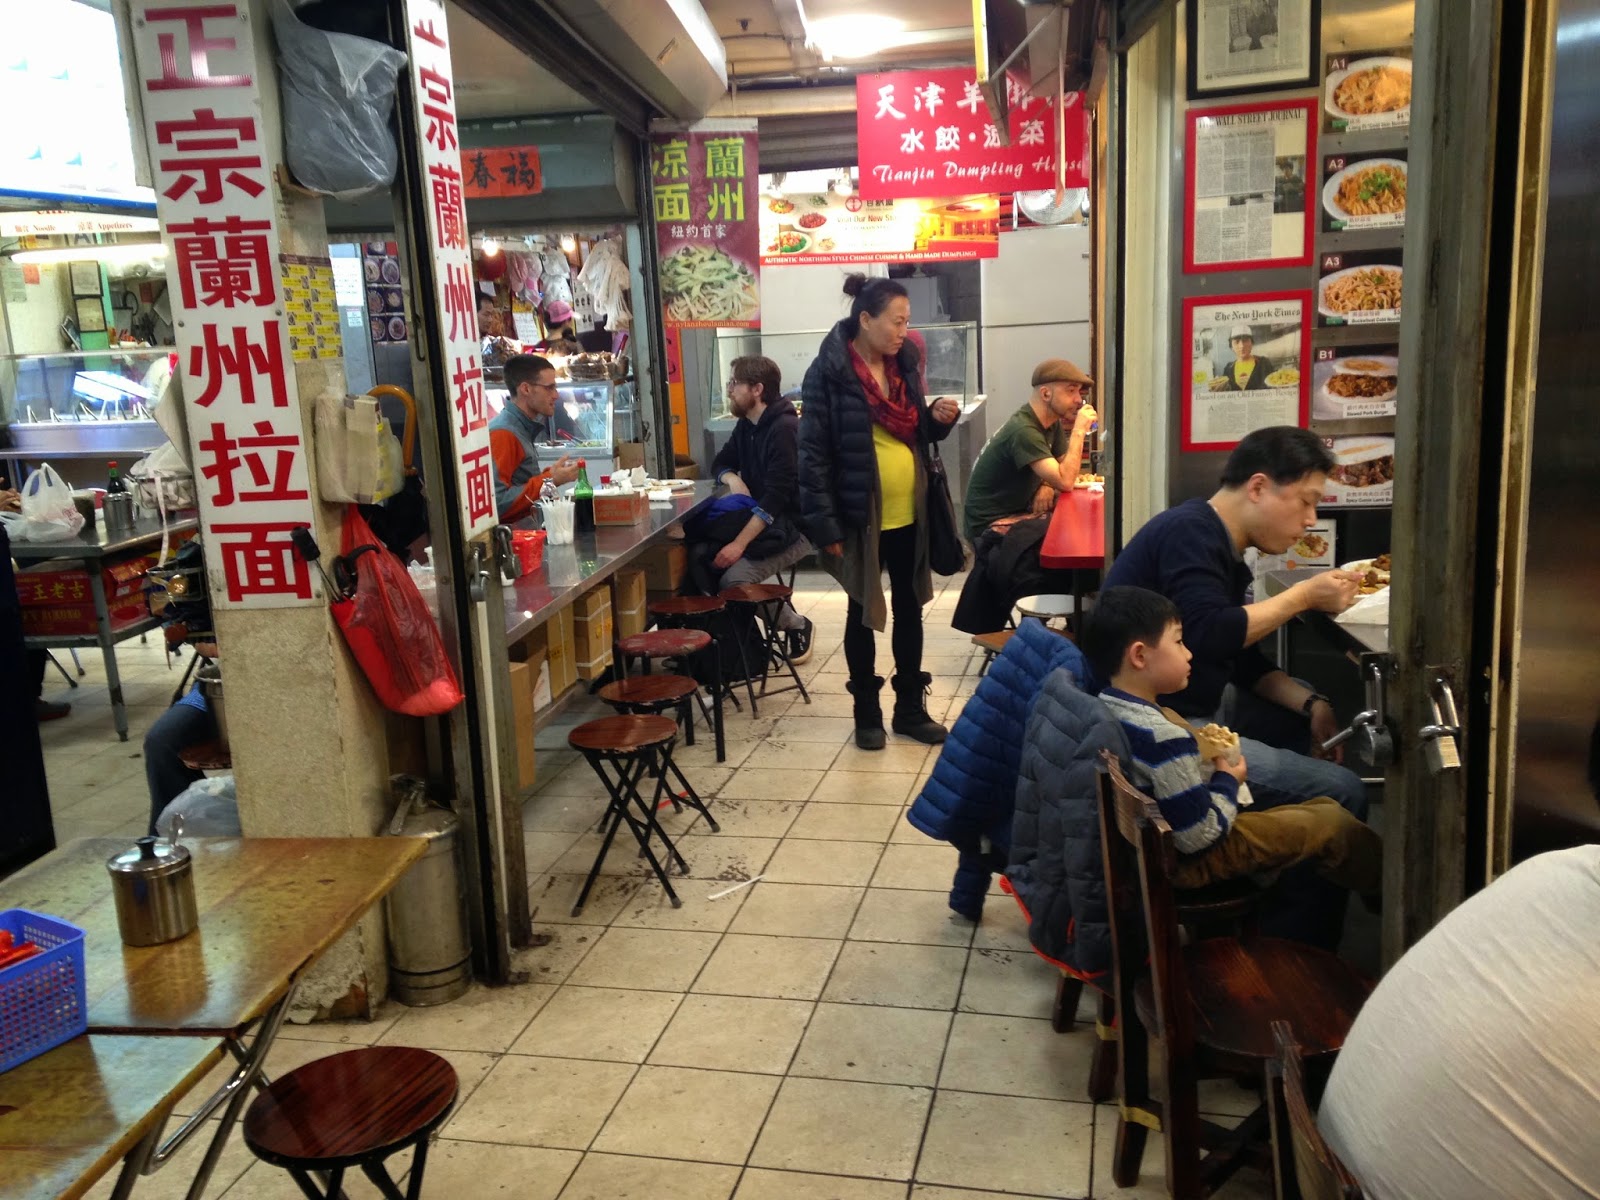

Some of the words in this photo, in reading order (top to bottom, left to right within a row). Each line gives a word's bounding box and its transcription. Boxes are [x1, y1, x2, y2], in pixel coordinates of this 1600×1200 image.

[1331, 58, 1346, 69] A1
[1216, 116, 1236, 126] WALL
[1237, 112, 1267, 125] STREET
[1268, 109, 1303, 122] JOURNAL
[1328, 158, 1344, 169] A2
[872, 164, 935, 185] Tianjin
[943, 158, 1024, 184] Dumpling
[1032, 155, 1082, 173] Hse
[704, 137, 745, 222] 蘭州
[853, 214, 866, 223] Our
[868, 214, 884, 223] New
[33, 224, 57, 232] Noodle
[97, 222, 133, 231] Appetizers
[765, 256, 798, 264] AUTHENTIC
[799, 255, 832, 263] NORTHERN
[832, 254, 849, 263] STYLE
[849, 253, 874, 262] CHINESE
[874, 252, 898, 261] CUISINE
[905, 252, 923, 260] HAND
[924, 251, 941, 259] MADE
[942, 250, 977, 258] DUMPLINGS
[1325, 257, 1340, 267] A3
[144, 3, 313, 602] 正宗蘭州拉面
[1214, 311, 1231, 322] The
[1232, 310, 1250, 321] New
[1252, 308, 1273, 321] York
[1274, 307, 1301, 319] Times
[1319, 350, 1333, 359] B1
[33, 581, 85, 601] 王老吉
